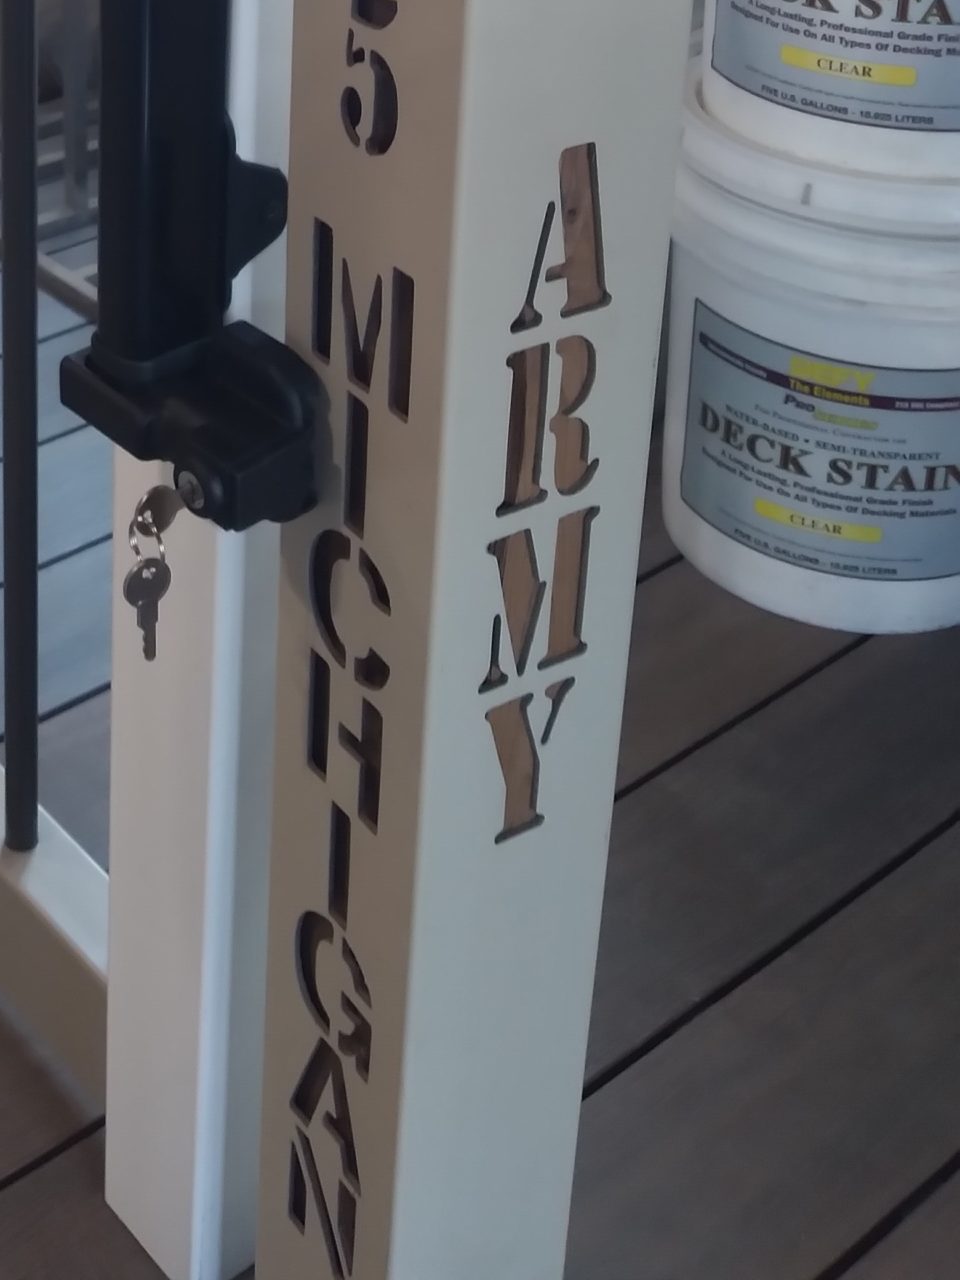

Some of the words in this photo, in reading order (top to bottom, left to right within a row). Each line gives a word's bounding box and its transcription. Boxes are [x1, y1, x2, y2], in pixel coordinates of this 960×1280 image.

[782, 24, 800, 36] Use
[803, 29, 817, 40] On
[820, 33, 835, 44] All
[838, 36, 871, 50] Types
[875, 41, 889, 52] Of
[892, 44, 943, 58] Decking
[820, 19, 893, 39] Professional
[897, 31, 934, 42] Grade
[817, 57, 873, 78] CLEAR
[699, 401, 814, 478] DECK
[478, 141, 612, 846] ARMY
[790, 514, 842, 535] CLEAR
[288, 217, 416, 1280] MICHIGAN
